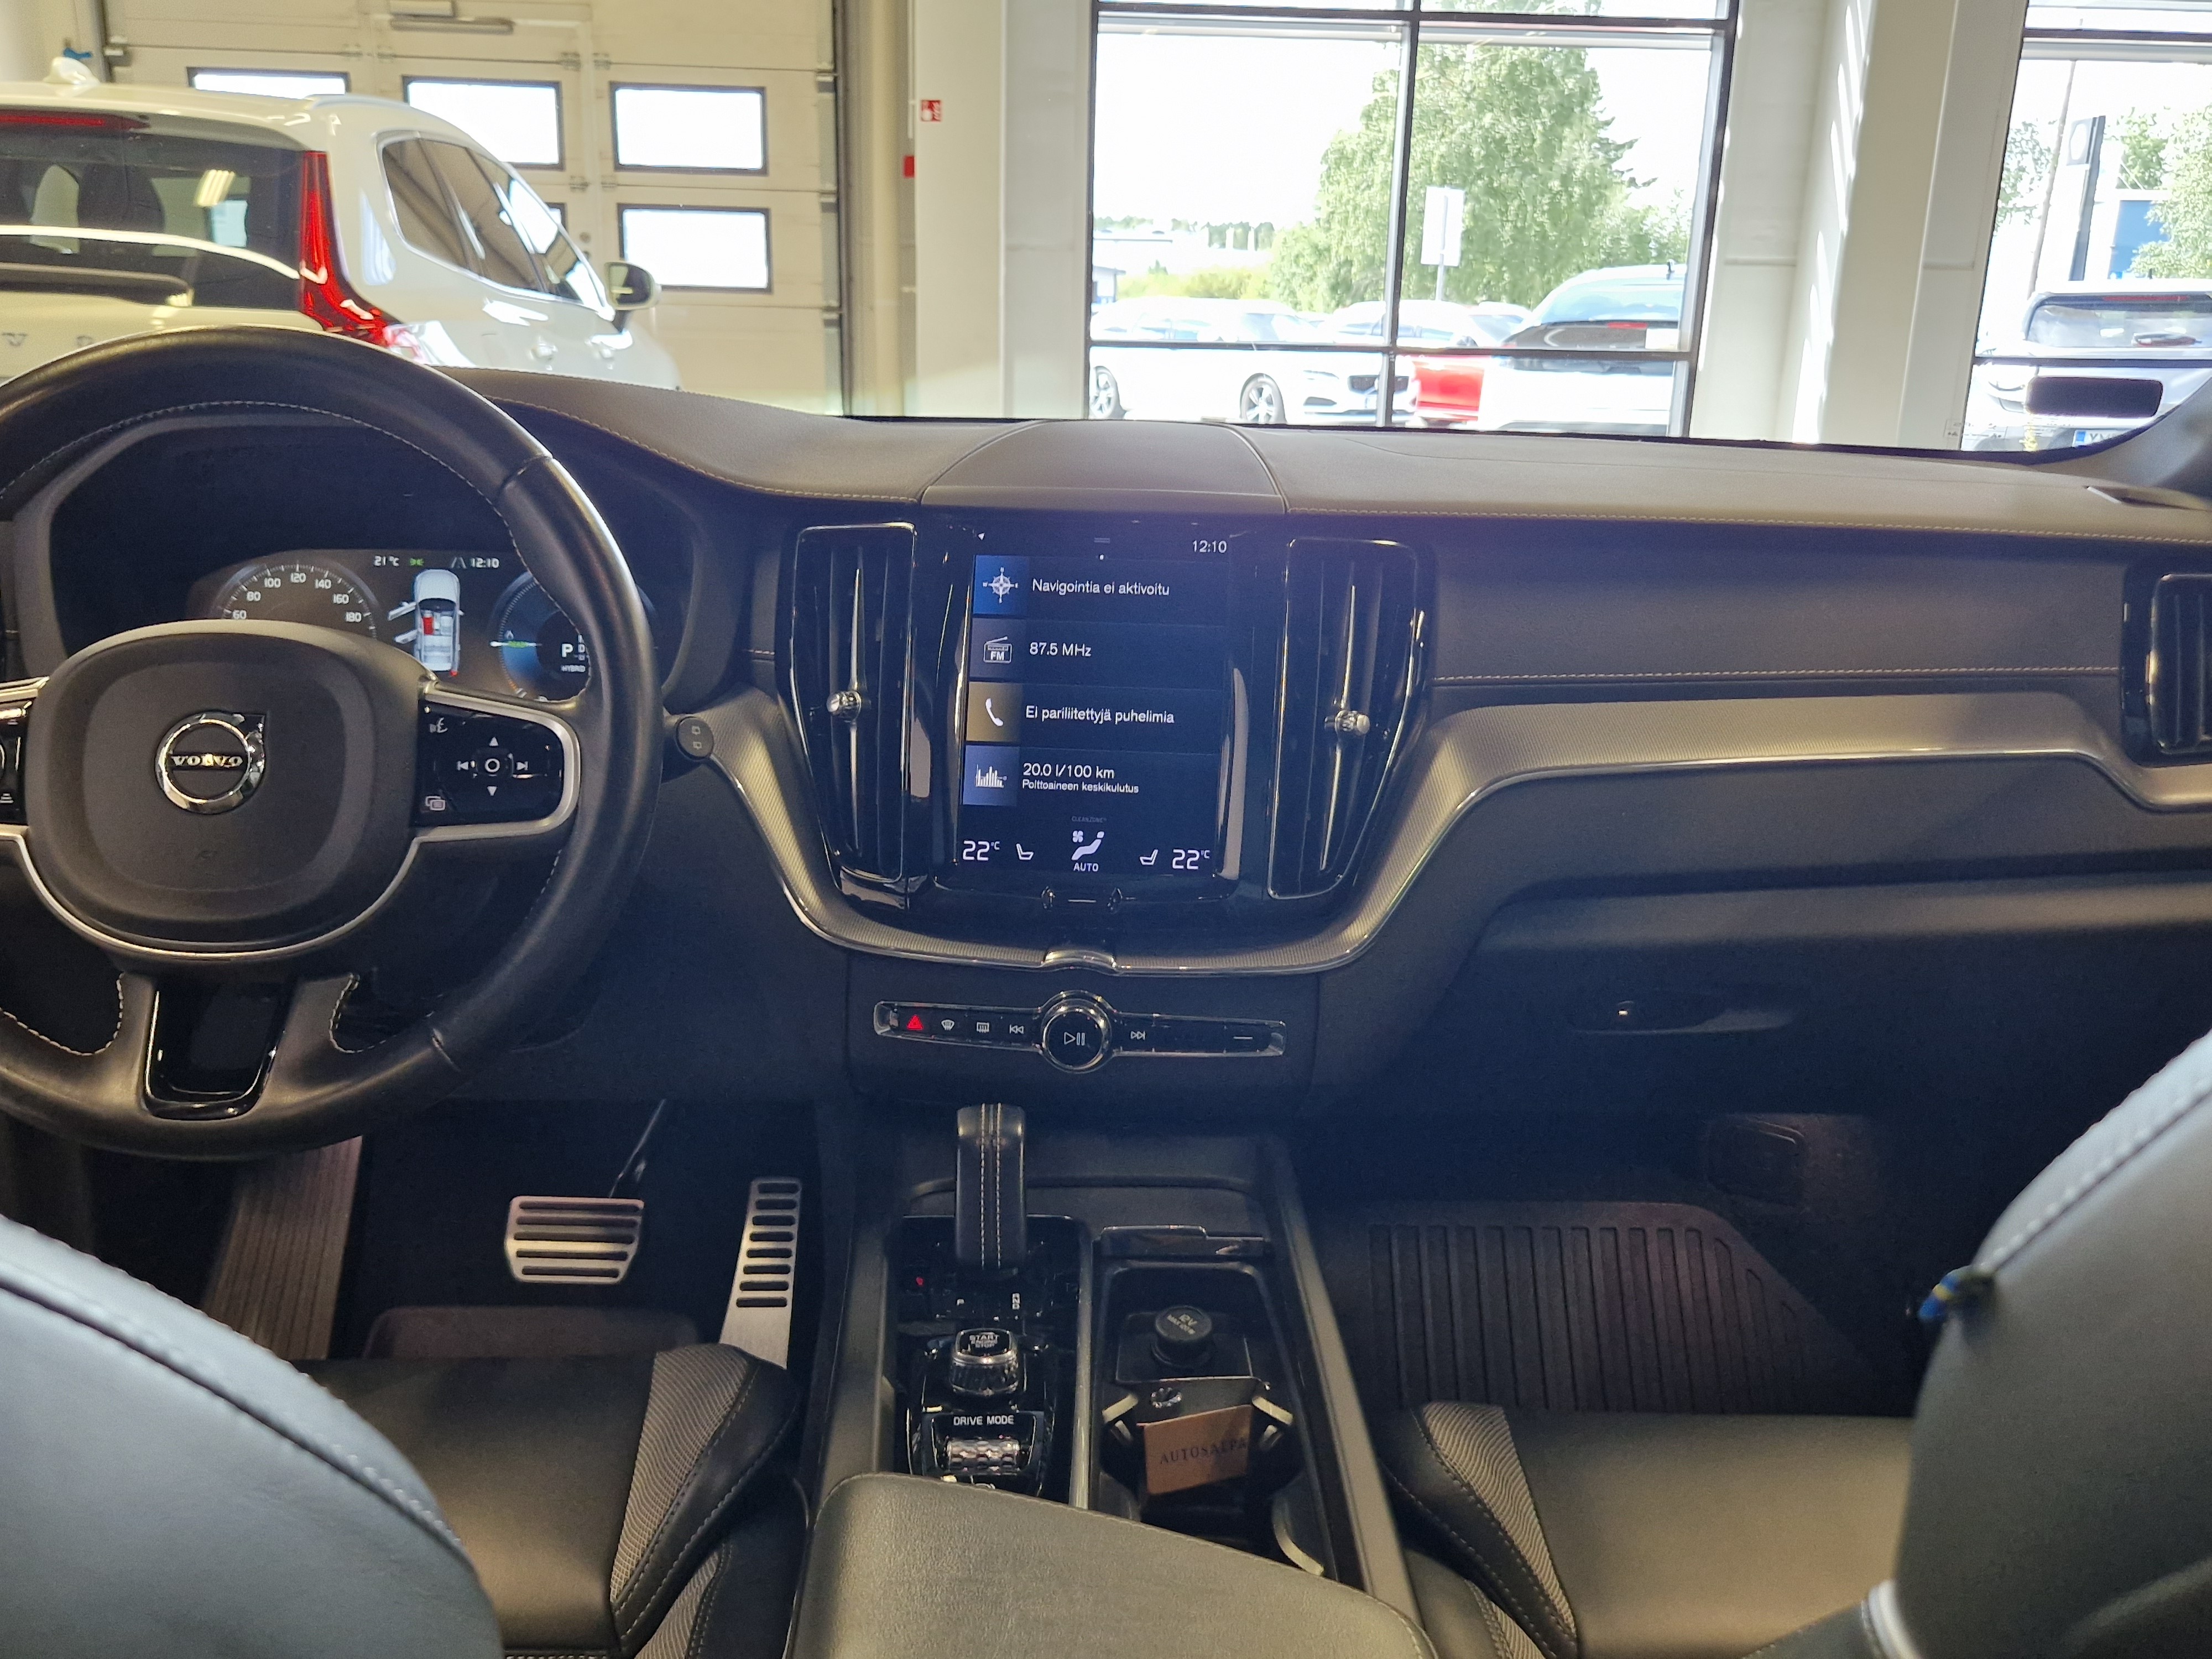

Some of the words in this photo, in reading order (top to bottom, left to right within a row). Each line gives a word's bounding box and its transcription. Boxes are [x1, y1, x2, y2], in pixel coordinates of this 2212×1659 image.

[1192, 540, 1227, 554] 12:10
[374, 555, 386, 566] 21
[471, 557, 499, 568] 12:10
[264, 577, 281, 588] 100
[290, 572, 306, 583] 120
[315, 579, 331, 589] 140
[1032, 578, 1100, 596] Navigointia
[1104, 581, 1114, 594] ei
[1118, 581, 1170, 596] aktivoitu
[247, 591, 261, 602] 80
[333, 593, 349, 604] 160
[232, 610, 247, 619] 60
[346, 612, 361, 622] 180
[561, 643, 573, 658] P
[1029, 642, 1058, 656] 87.5
[1062, 643, 1092, 656] MHz
[990, 651, 1005, 661] FM
[1026, 705, 1038, 718] Ei
[1042, 707, 1112, 724] pariliitettyjä
[1115, 709, 1175, 725] puhelimia
[171, 754, 243, 768] VOLVO
[1023, 763, 1051, 776] 20.0
[1096, 766, 1115, 779] km
[1022, 779, 1078, 791] Polttoaineen
[1082, 781, 1139, 793] keskikulutus
[1073, 863, 1099, 872] AUTO
[953, 1416, 983, 1426] DRIVE
[987, 1415, 1014, 1425] MODE
